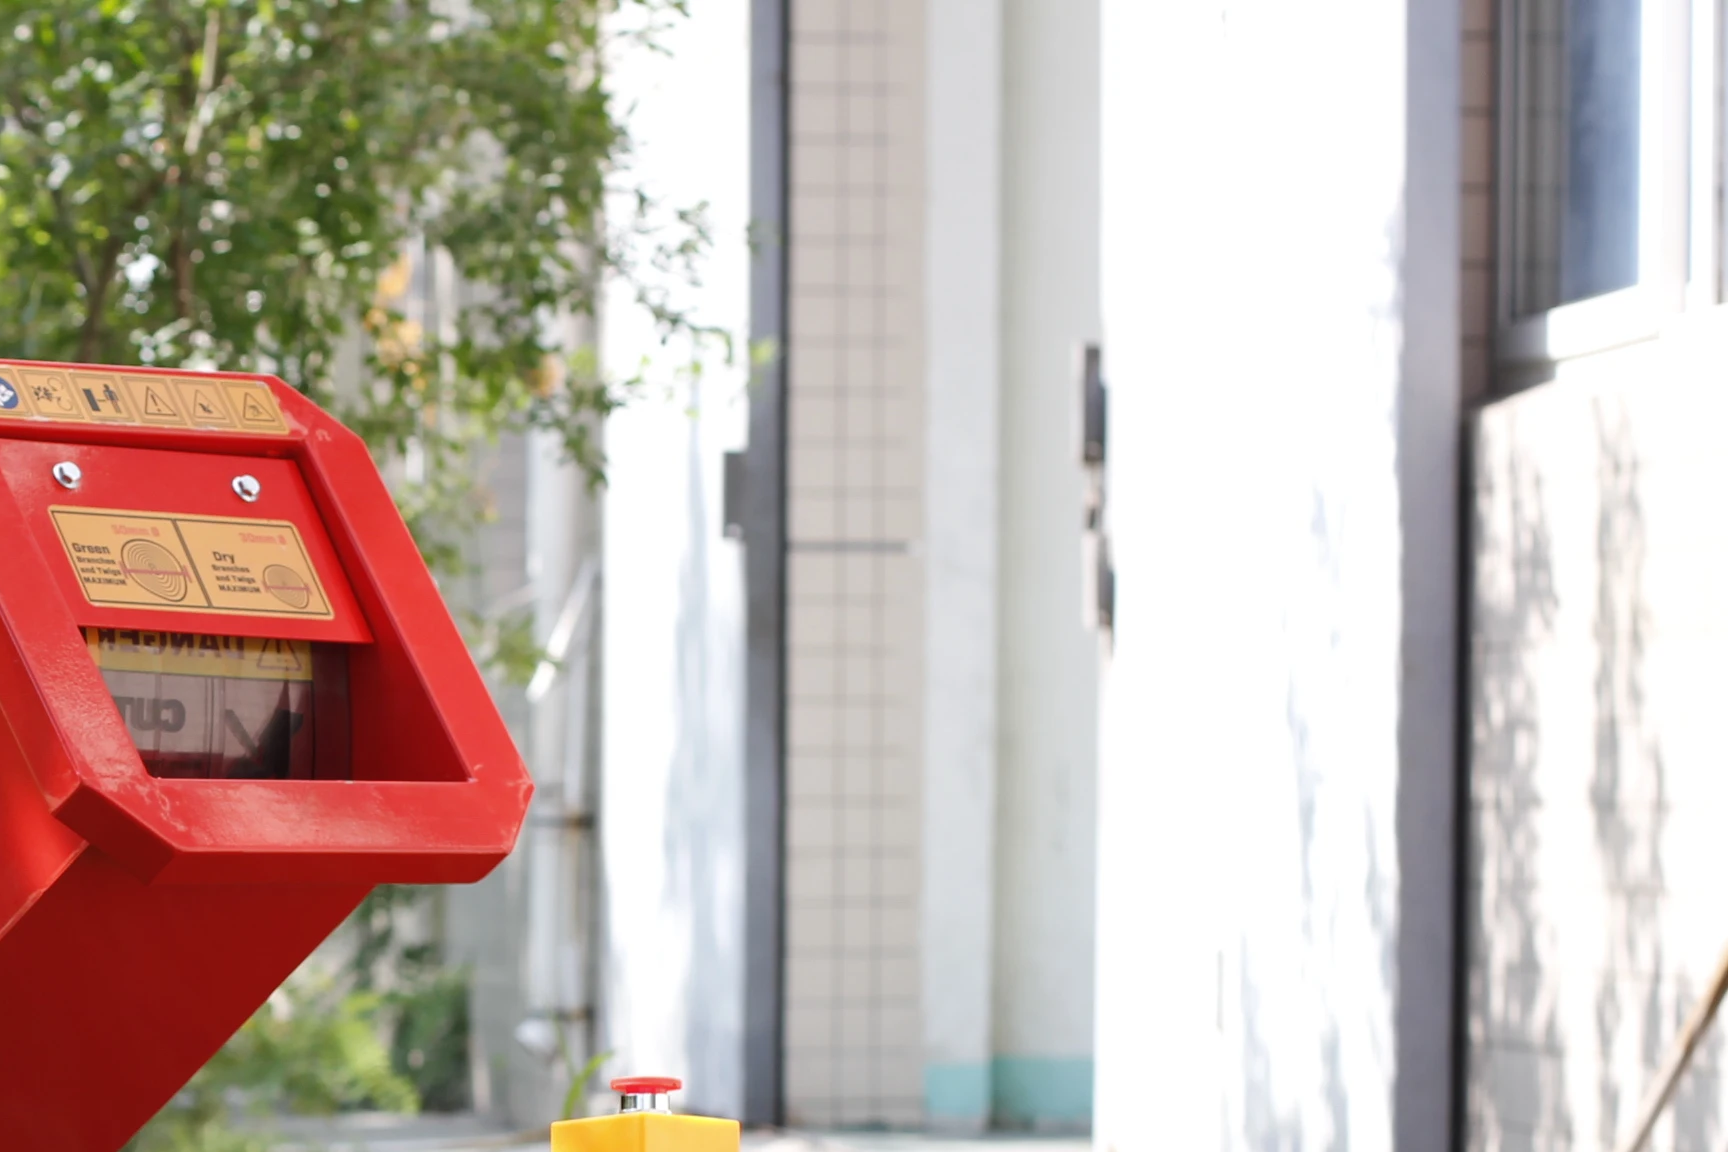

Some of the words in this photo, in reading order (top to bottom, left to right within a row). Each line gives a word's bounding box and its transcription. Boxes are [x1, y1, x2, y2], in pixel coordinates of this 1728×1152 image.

[72, 543, 110, 554] Green
[76, 556, 116, 564] Branches
[213, 551, 235, 564] Dry
[98, 568, 121, 576] Twigs
[212, 564, 250, 572] Branches
[83, 577, 127, 586] MAXIMUM
[232, 576, 256, 584] Twigs
[218, 584, 261, 593] MAXIMUM
